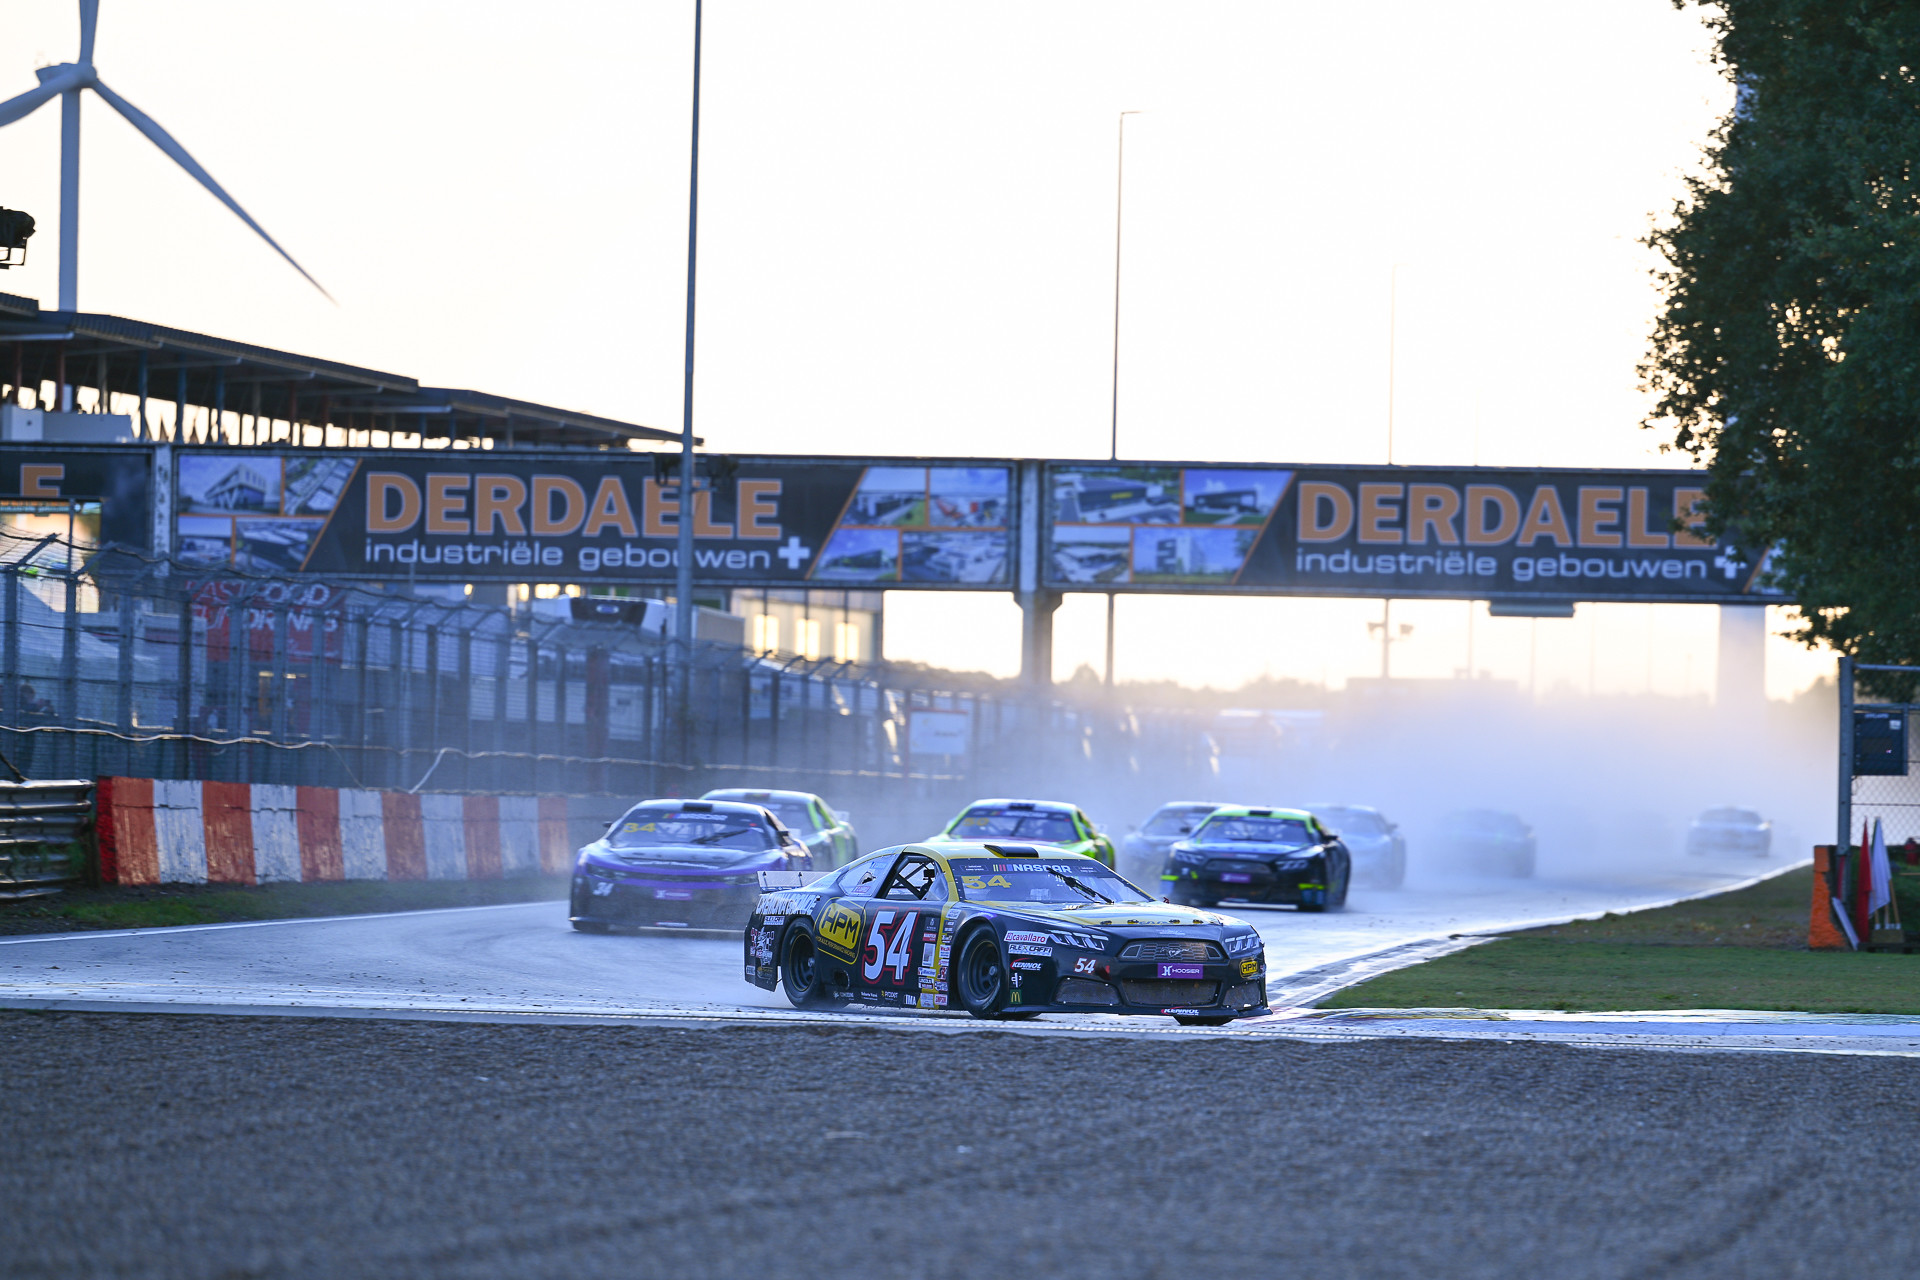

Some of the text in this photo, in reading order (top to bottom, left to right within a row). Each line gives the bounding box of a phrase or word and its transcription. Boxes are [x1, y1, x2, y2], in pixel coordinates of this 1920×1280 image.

[366, 471, 782, 540] DERDAELE
[1297, 481, 1718, 550] DERDAELE
[365, 537, 771, 572] industriële gebowen
[1296, 547, 1707, 582] industriële gebouwen
[623, 822, 656, 833] 34
[961, 875, 1012, 889] 54
[1013, 864, 1072, 873] NASCAR
[821, 906, 860, 944] HPM
[1012, 932, 1046, 943] cavallaro
[862, 907, 919, 984] 54
[1074, 957, 1097, 974] 54
